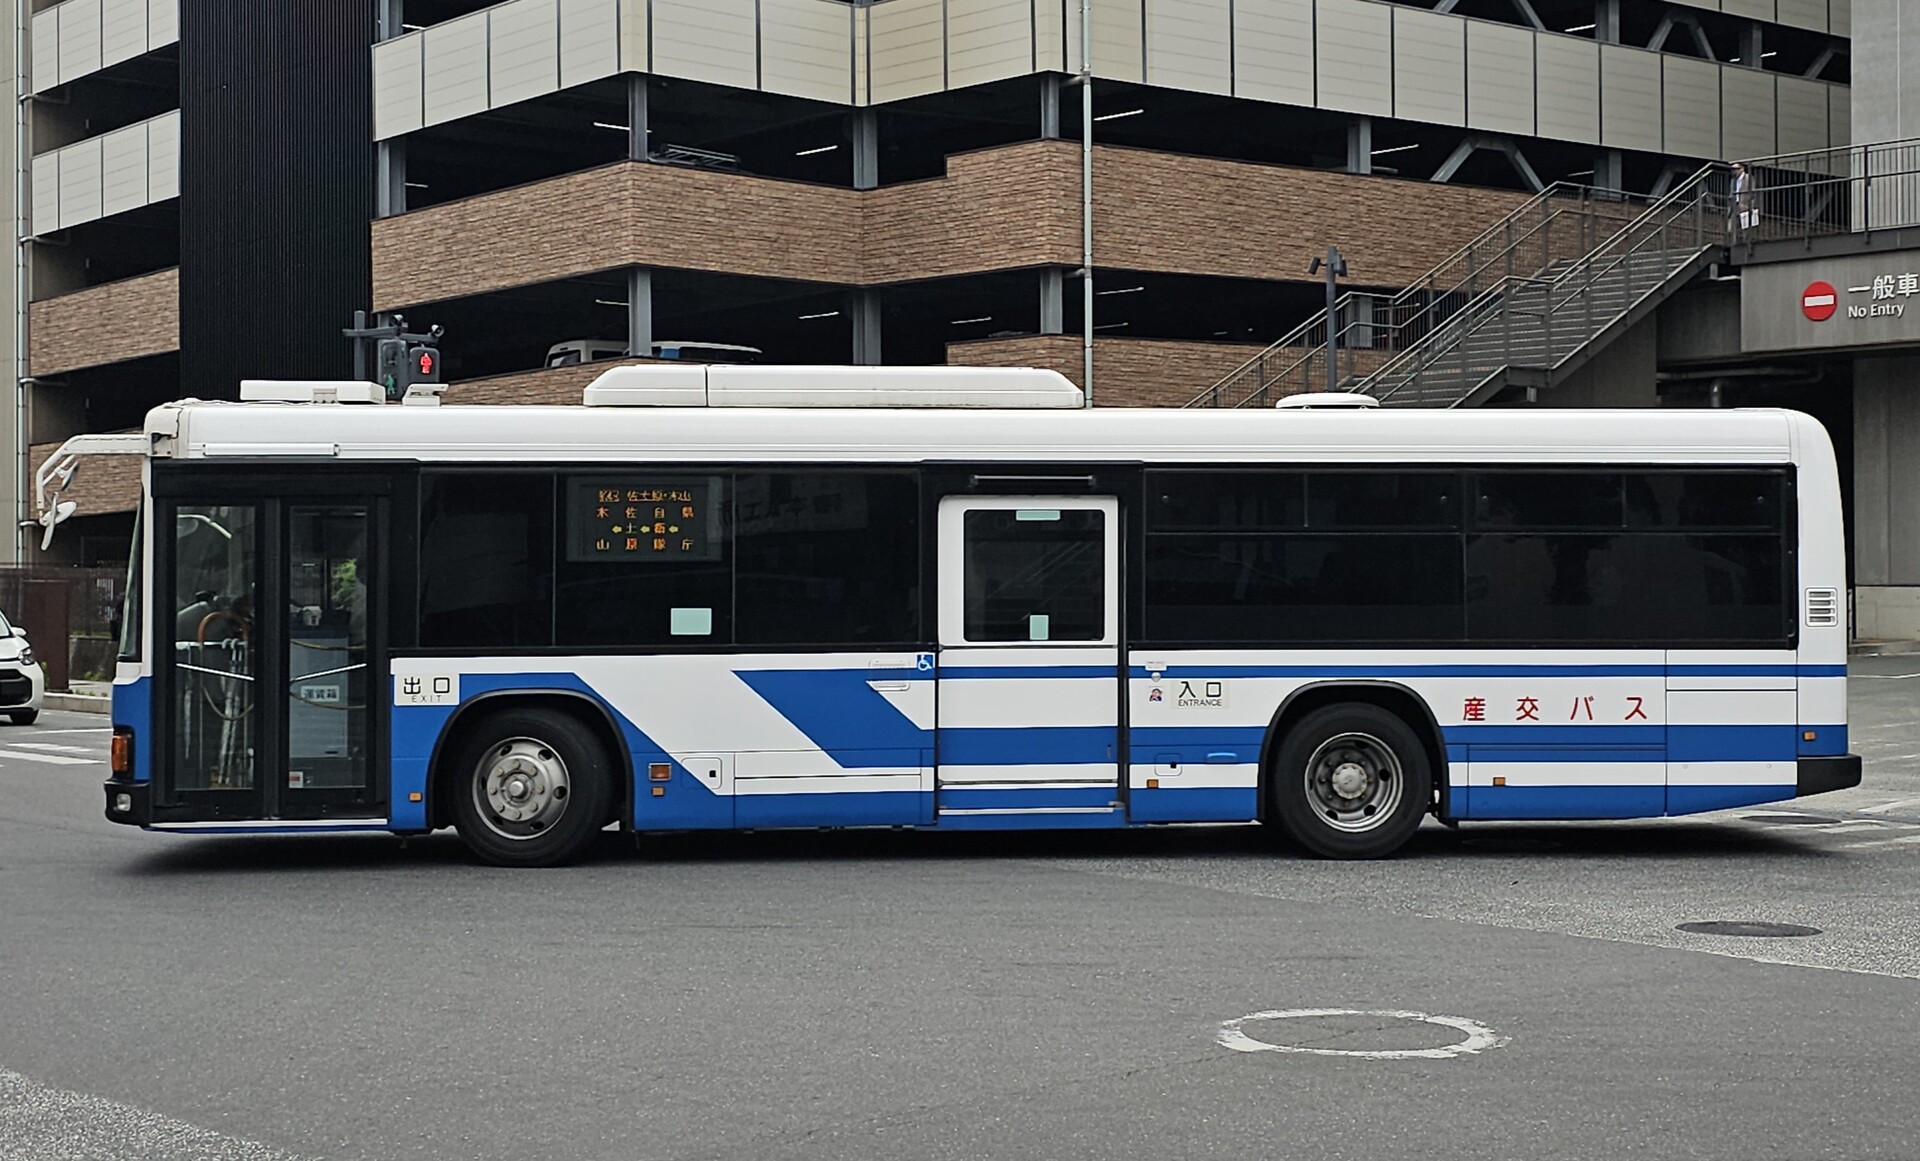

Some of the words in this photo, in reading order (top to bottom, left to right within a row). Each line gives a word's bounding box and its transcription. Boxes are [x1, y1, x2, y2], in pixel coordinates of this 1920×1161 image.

[1847, 272, 1920, 300] 一般車
[1847, 305, 1867, 318] No
[1870, 303, 1905, 318] Entry
[403, 676, 450, 694] 出口
[1178, 681, 1222, 698] 入口
[411, 695, 442, 703] EXIT
[1178, 699, 1222, 707] ENTRANCE
[1463, 696, 1648, 721] 産交バス
